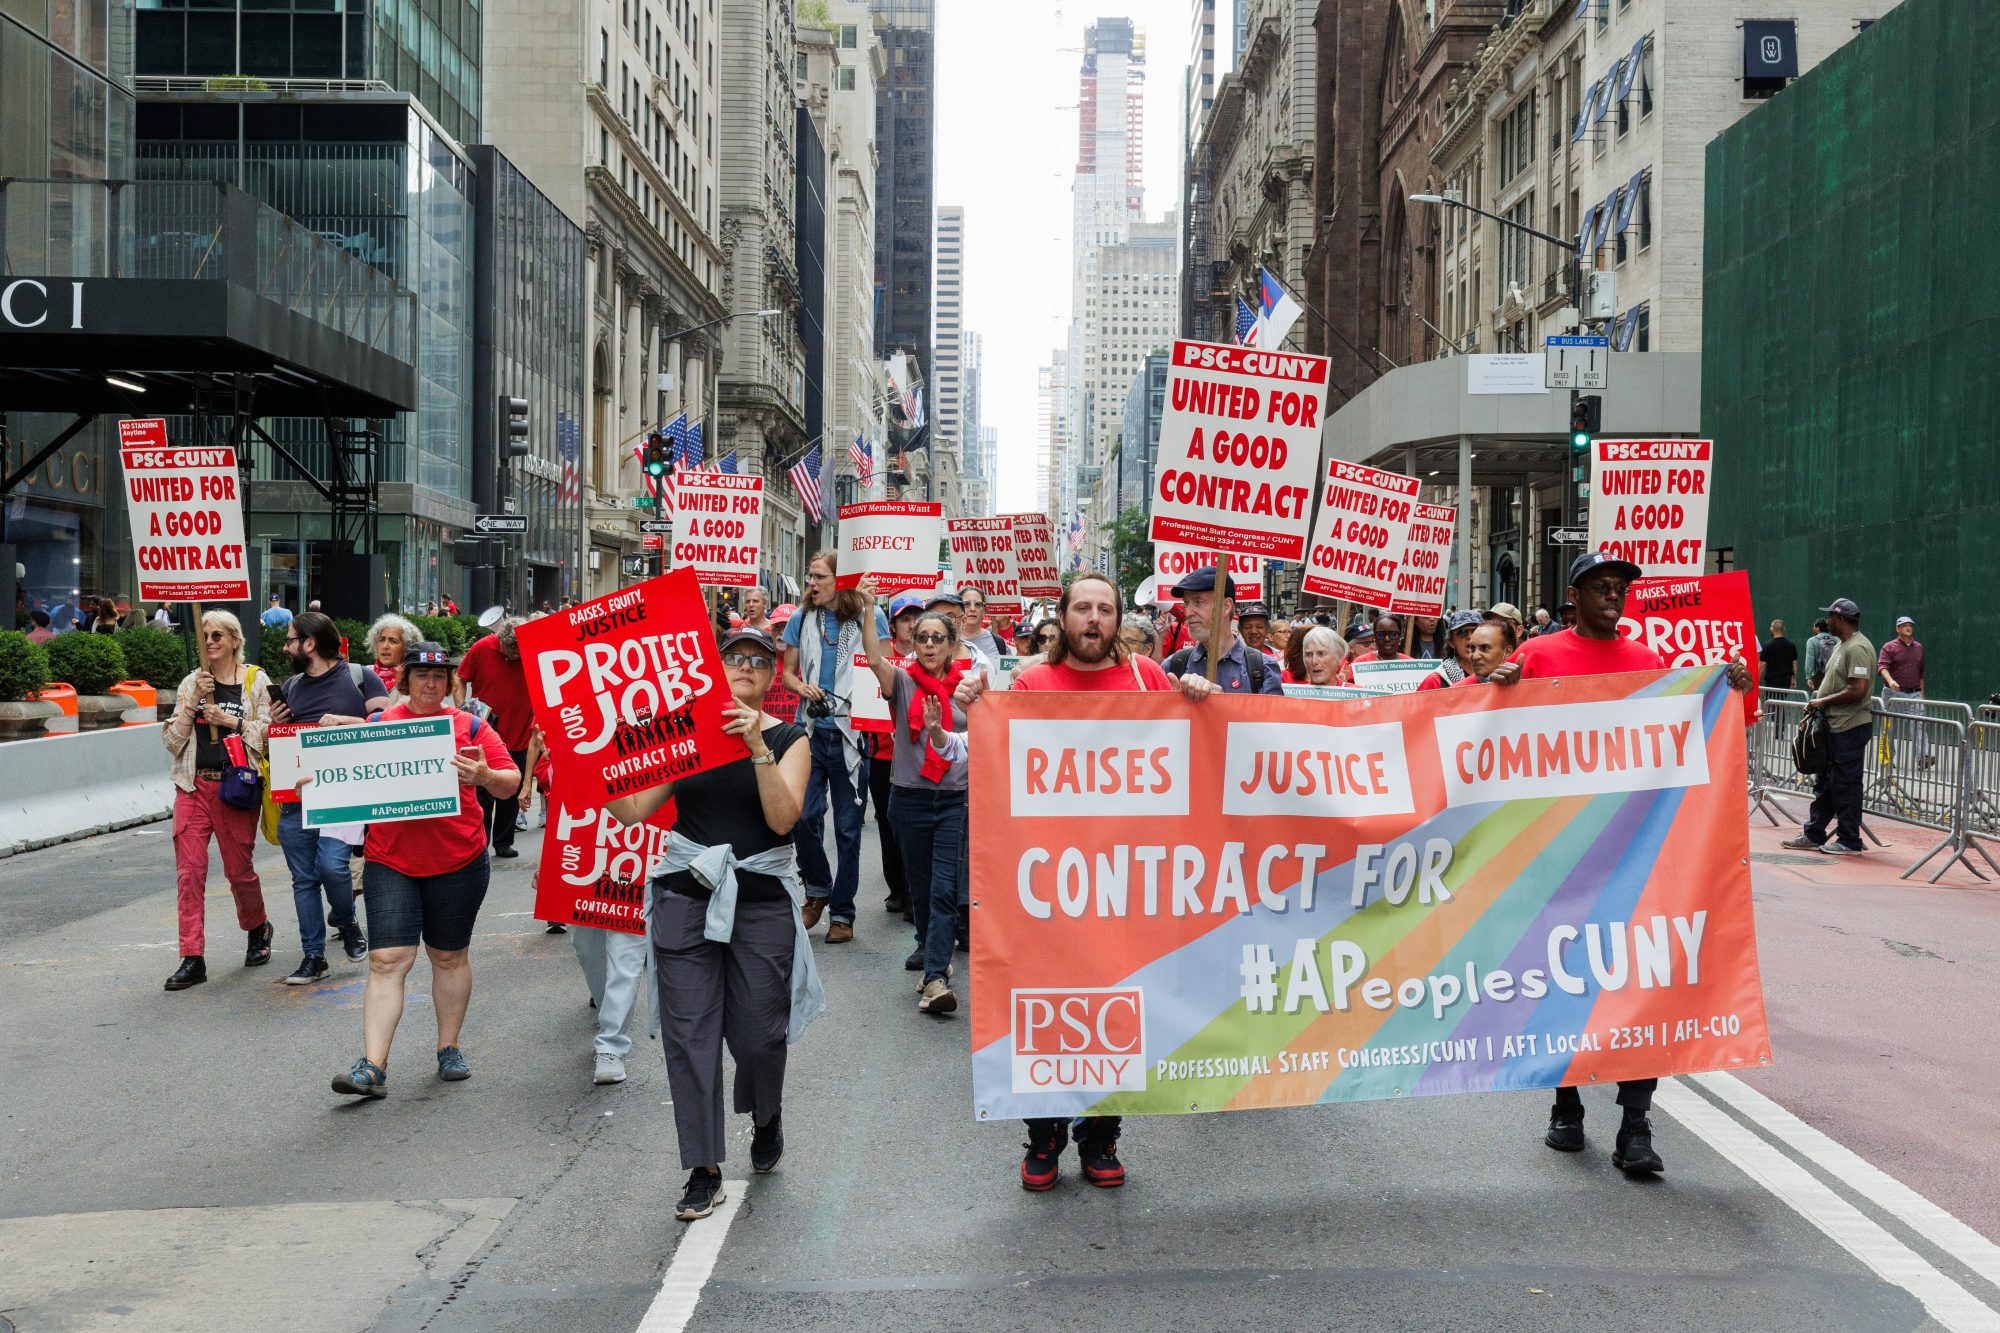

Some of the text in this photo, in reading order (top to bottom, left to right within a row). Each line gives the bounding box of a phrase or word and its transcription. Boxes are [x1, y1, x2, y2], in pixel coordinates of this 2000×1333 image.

[1, 279, 84, 328] CI
[1184, 345, 1317, 380] PSC-CUNY
[1172, 378, 1318, 428] UNITED FOR
[132, 451, 226, 468] PSC-CUNY
[1187, 427, 1288, 470] A GOOD
[1607, 444, 1702, 460] PSC-CUNY
[130, 477, 194, 502] UNITED
[200, 476, 236, 500] FOR
[684, 474, 758, 489] PSC-CUNY
[1336, 464, 1412, 492] PSC-CUNY
[1602, 470, 1662, 496] UNITED
[1667, 469, 1705, 494] FOR
[678, 492, 759, 514] UNITED FOR
[1159, 469, 1309, 520] CONTRACT
[1326, 484, 1410, 524] UNITED FOR
[840, 504, 930, 516] PSC/CUNY Members Want
[1414, 504, 1452, 520] C-CUNY
[1614, 504, 1684, 531] A GOOD
[150, 511, 222, 536] A GOOD
[689, 518, 744, 538] A GOOD
[954, 520, 1006, 530] PSC-CUNY
[1014, 528, 1050, 544] ITED FOR
[1161, 520, 1296, 545] Professional Staff Congress CUNY
[1331, 518, 1389, 550] A GOOD
[1408, 524, 1451, 546] ITED FOR
[852, 536, 914, 552] RESPECT
[952, 536, 1013, 552] UNITED FOR
[1196, 534, 1216, 542] Local
[139, 544, 242, 571] CONTRACT
[675, 543, 758, 565] CONTRACT
[966, 558, 1004, 574] A GOOD
[1021, 548, 1048, 562] GOOD
[1312, 544, 1398, 582] CONTRACT
[1402, 548, 1438, 569] A GOOD
[1397, 572, 1446, 595] ONTRACT
[1636, 580, 1702, 600] RAISES, EQUITY,
[569, 588, 645, 626] RAISES, EQUITY,
[1640, 592, 1702, 614] JUSTICE
[576, 604, 648, 642] JUSTICE
[538, 630, 704, 708] PROTECT
[574, 658, 712, 754] JOBS
[1322, 690, 1358, 698] Members
[560, 704, 588, 740] OUR
[635, 706, 650, 717] PSC
[306, 724, 435, 744] PSC/CUNY Members Want
[602, 739, 698, 781] CONTRACT FOR
[1456, 720, 1691, 784] COMMUNITY
[314, 758, 446, 788] JOB SECURITY
[606, 754, 702, 796] #APEOPLESCUNY
[1026, 747, 1172, 794] RAISES
[1240, 750, 1389, 796] JUSTICE
[372, 800, 453, 816] #APeoplesCUNY
[556, 801, 672, 857] PROTE
[561, 844, 582, 871] OUR
[620, 871, 632, 880] PSC
[1018, 838, 1454, 919] CONTRACT FOR
[572, 910, 646, 932] #APEOPLESCUN
[575, 898, 644, 920] CONTRACT FO
[1240, 910, 1708, 1019] #APeoplesCUNY
[1018, 996, 1139, 1053] PSC
[1502, 1033, 1537, 1058] AFT
[1609, 1024, 1654, 1050] 2334
[1674, 1014, 1741, 1043] AFL-CIO
[1029, 1058, 1130, 1086] CUNY
